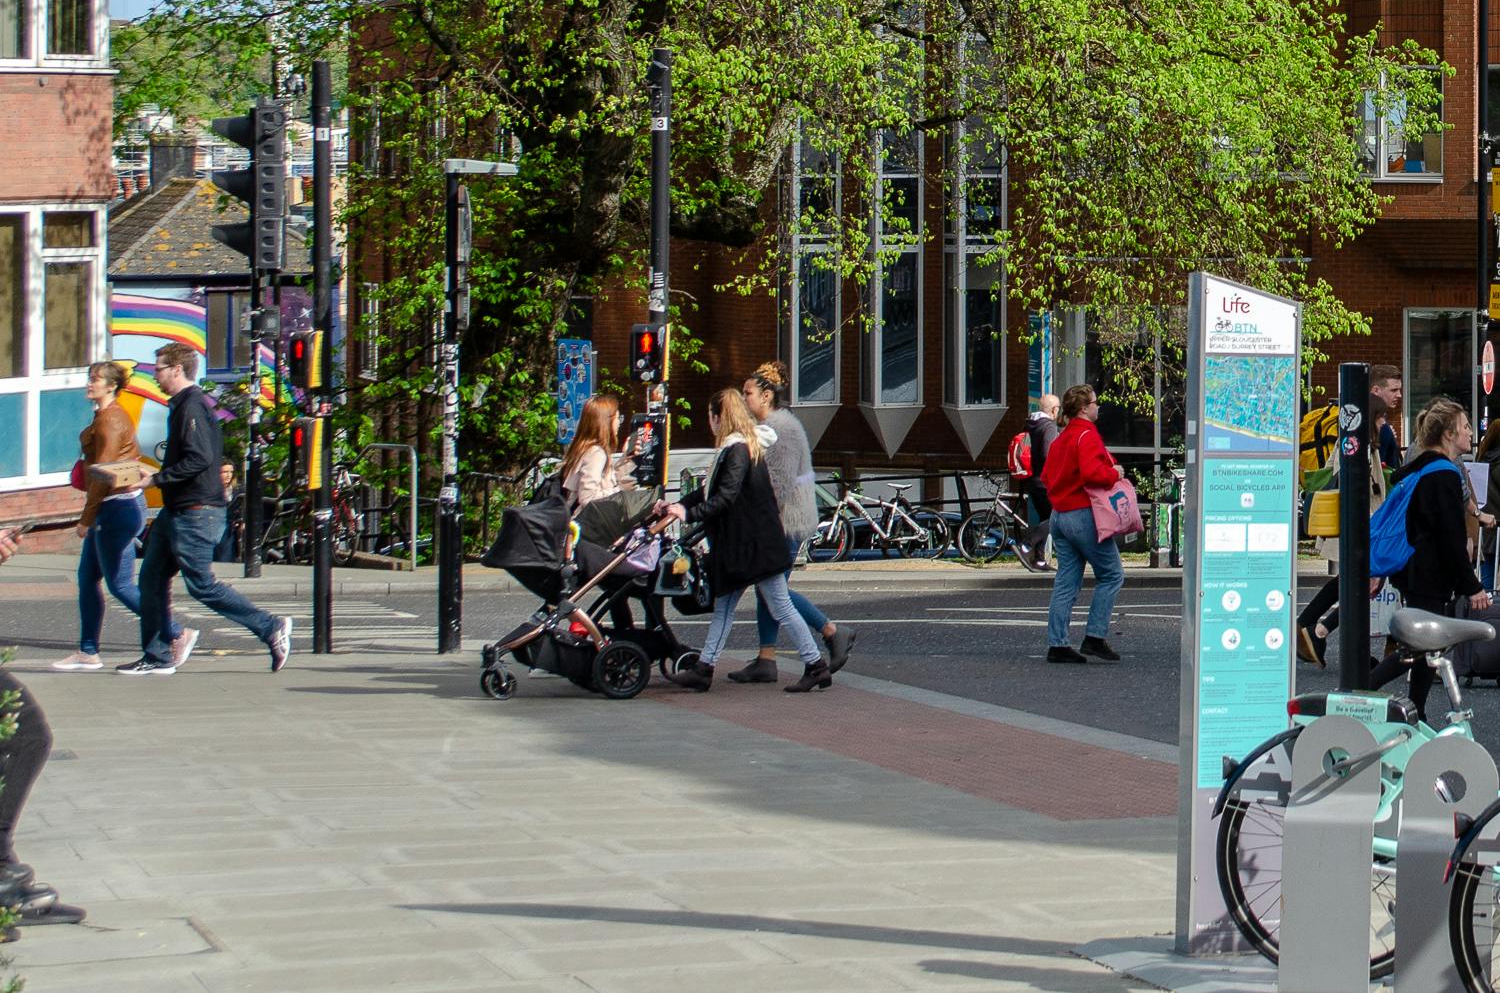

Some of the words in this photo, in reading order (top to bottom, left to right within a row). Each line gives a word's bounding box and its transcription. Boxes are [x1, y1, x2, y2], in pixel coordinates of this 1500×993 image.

[657, 119, 664, 128] 3
[1223, 296, 1250, 314] Life
[1234, 323, 1258, 334] BTN
